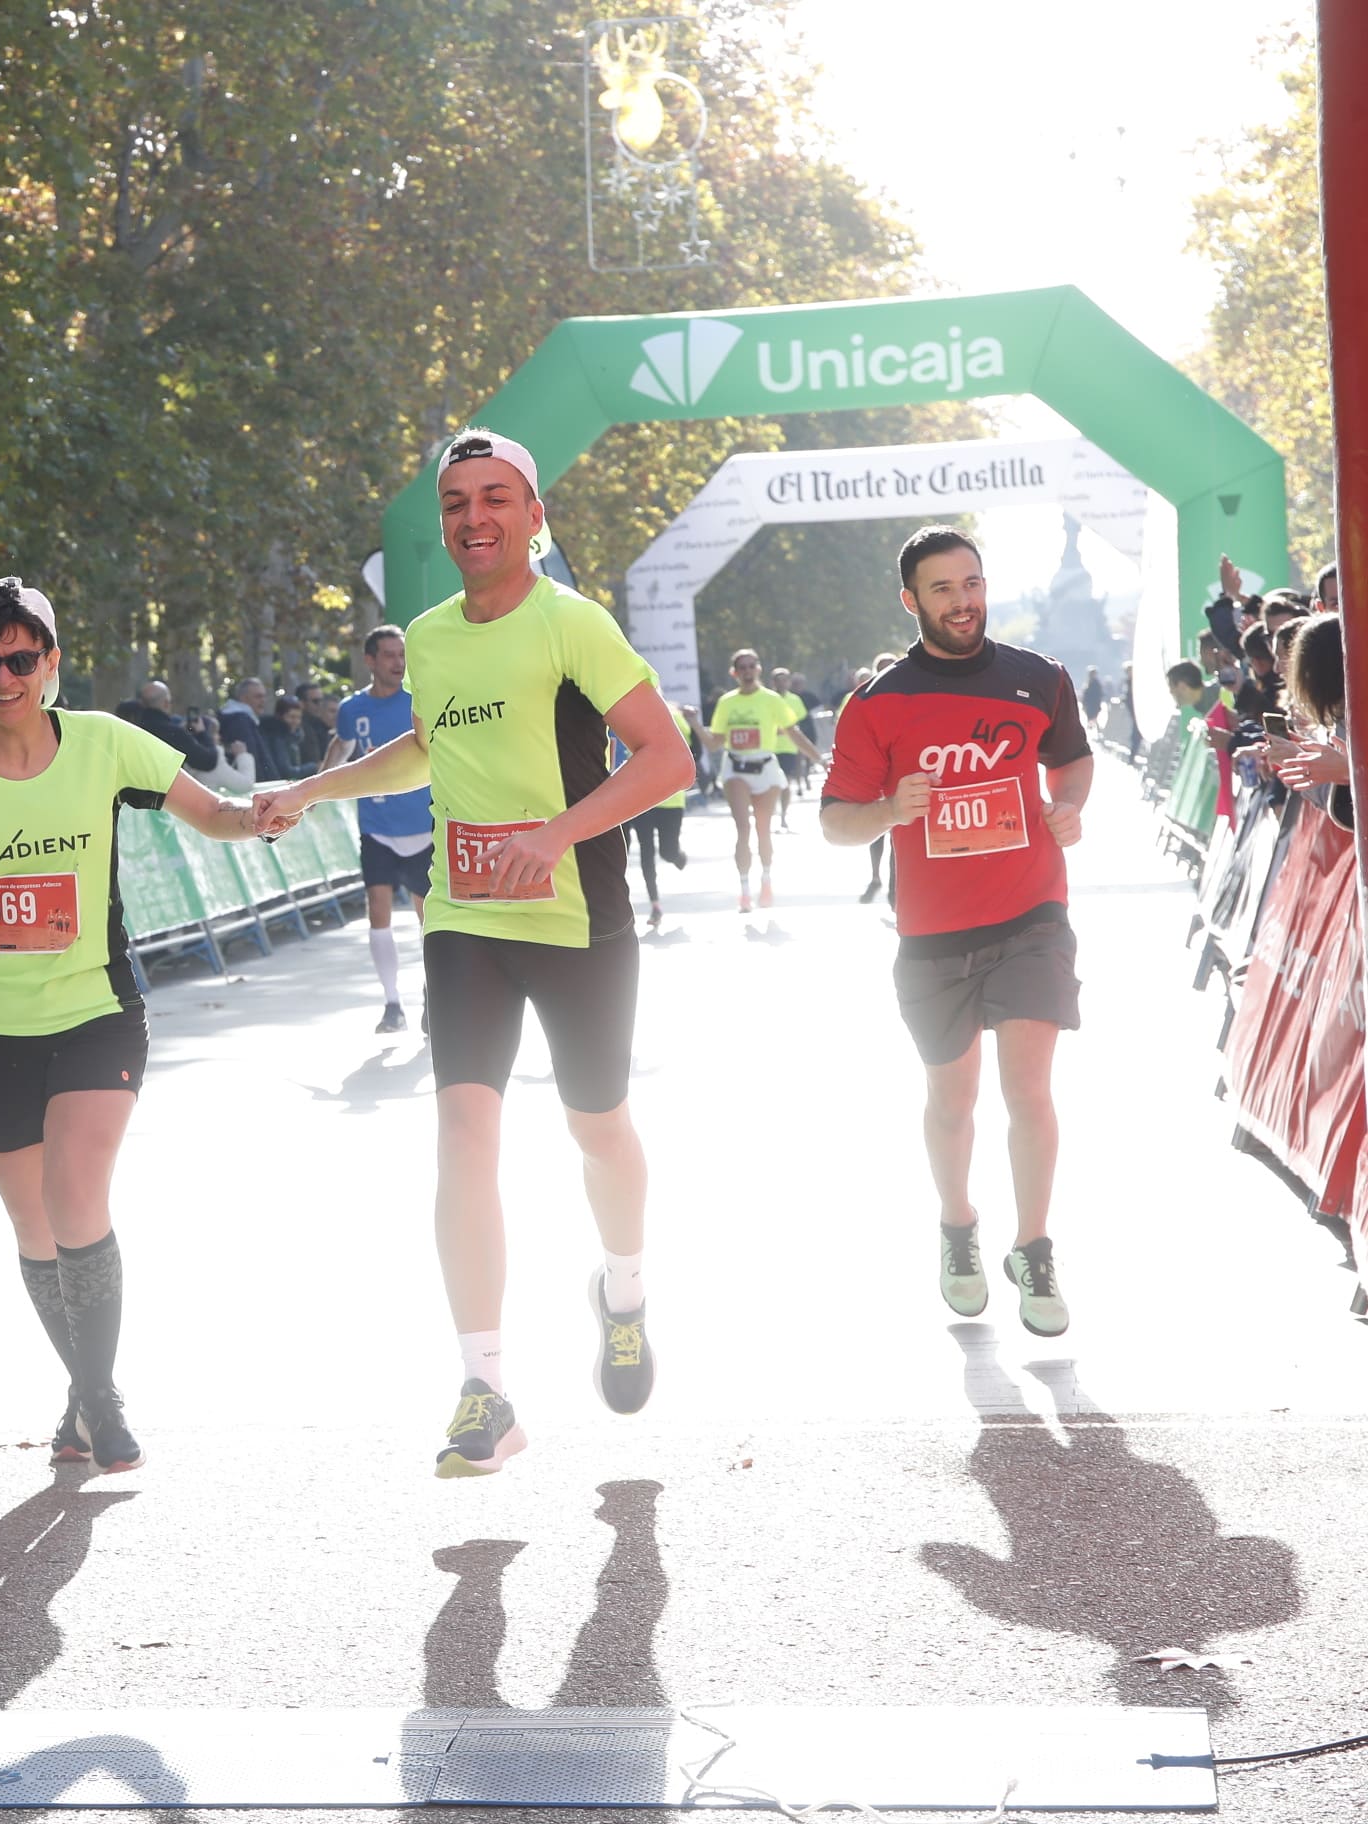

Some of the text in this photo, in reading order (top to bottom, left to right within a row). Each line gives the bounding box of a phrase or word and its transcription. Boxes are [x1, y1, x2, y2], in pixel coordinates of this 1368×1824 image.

[757, 325, 1004, 394] Unicaja
[767, 458, 1046, 505] El Norte de Castilla
[433, 699, 506, 731] ADIENT
[919, 740, 1010, 778] gmv
[937, 798, 988, 831] 400
